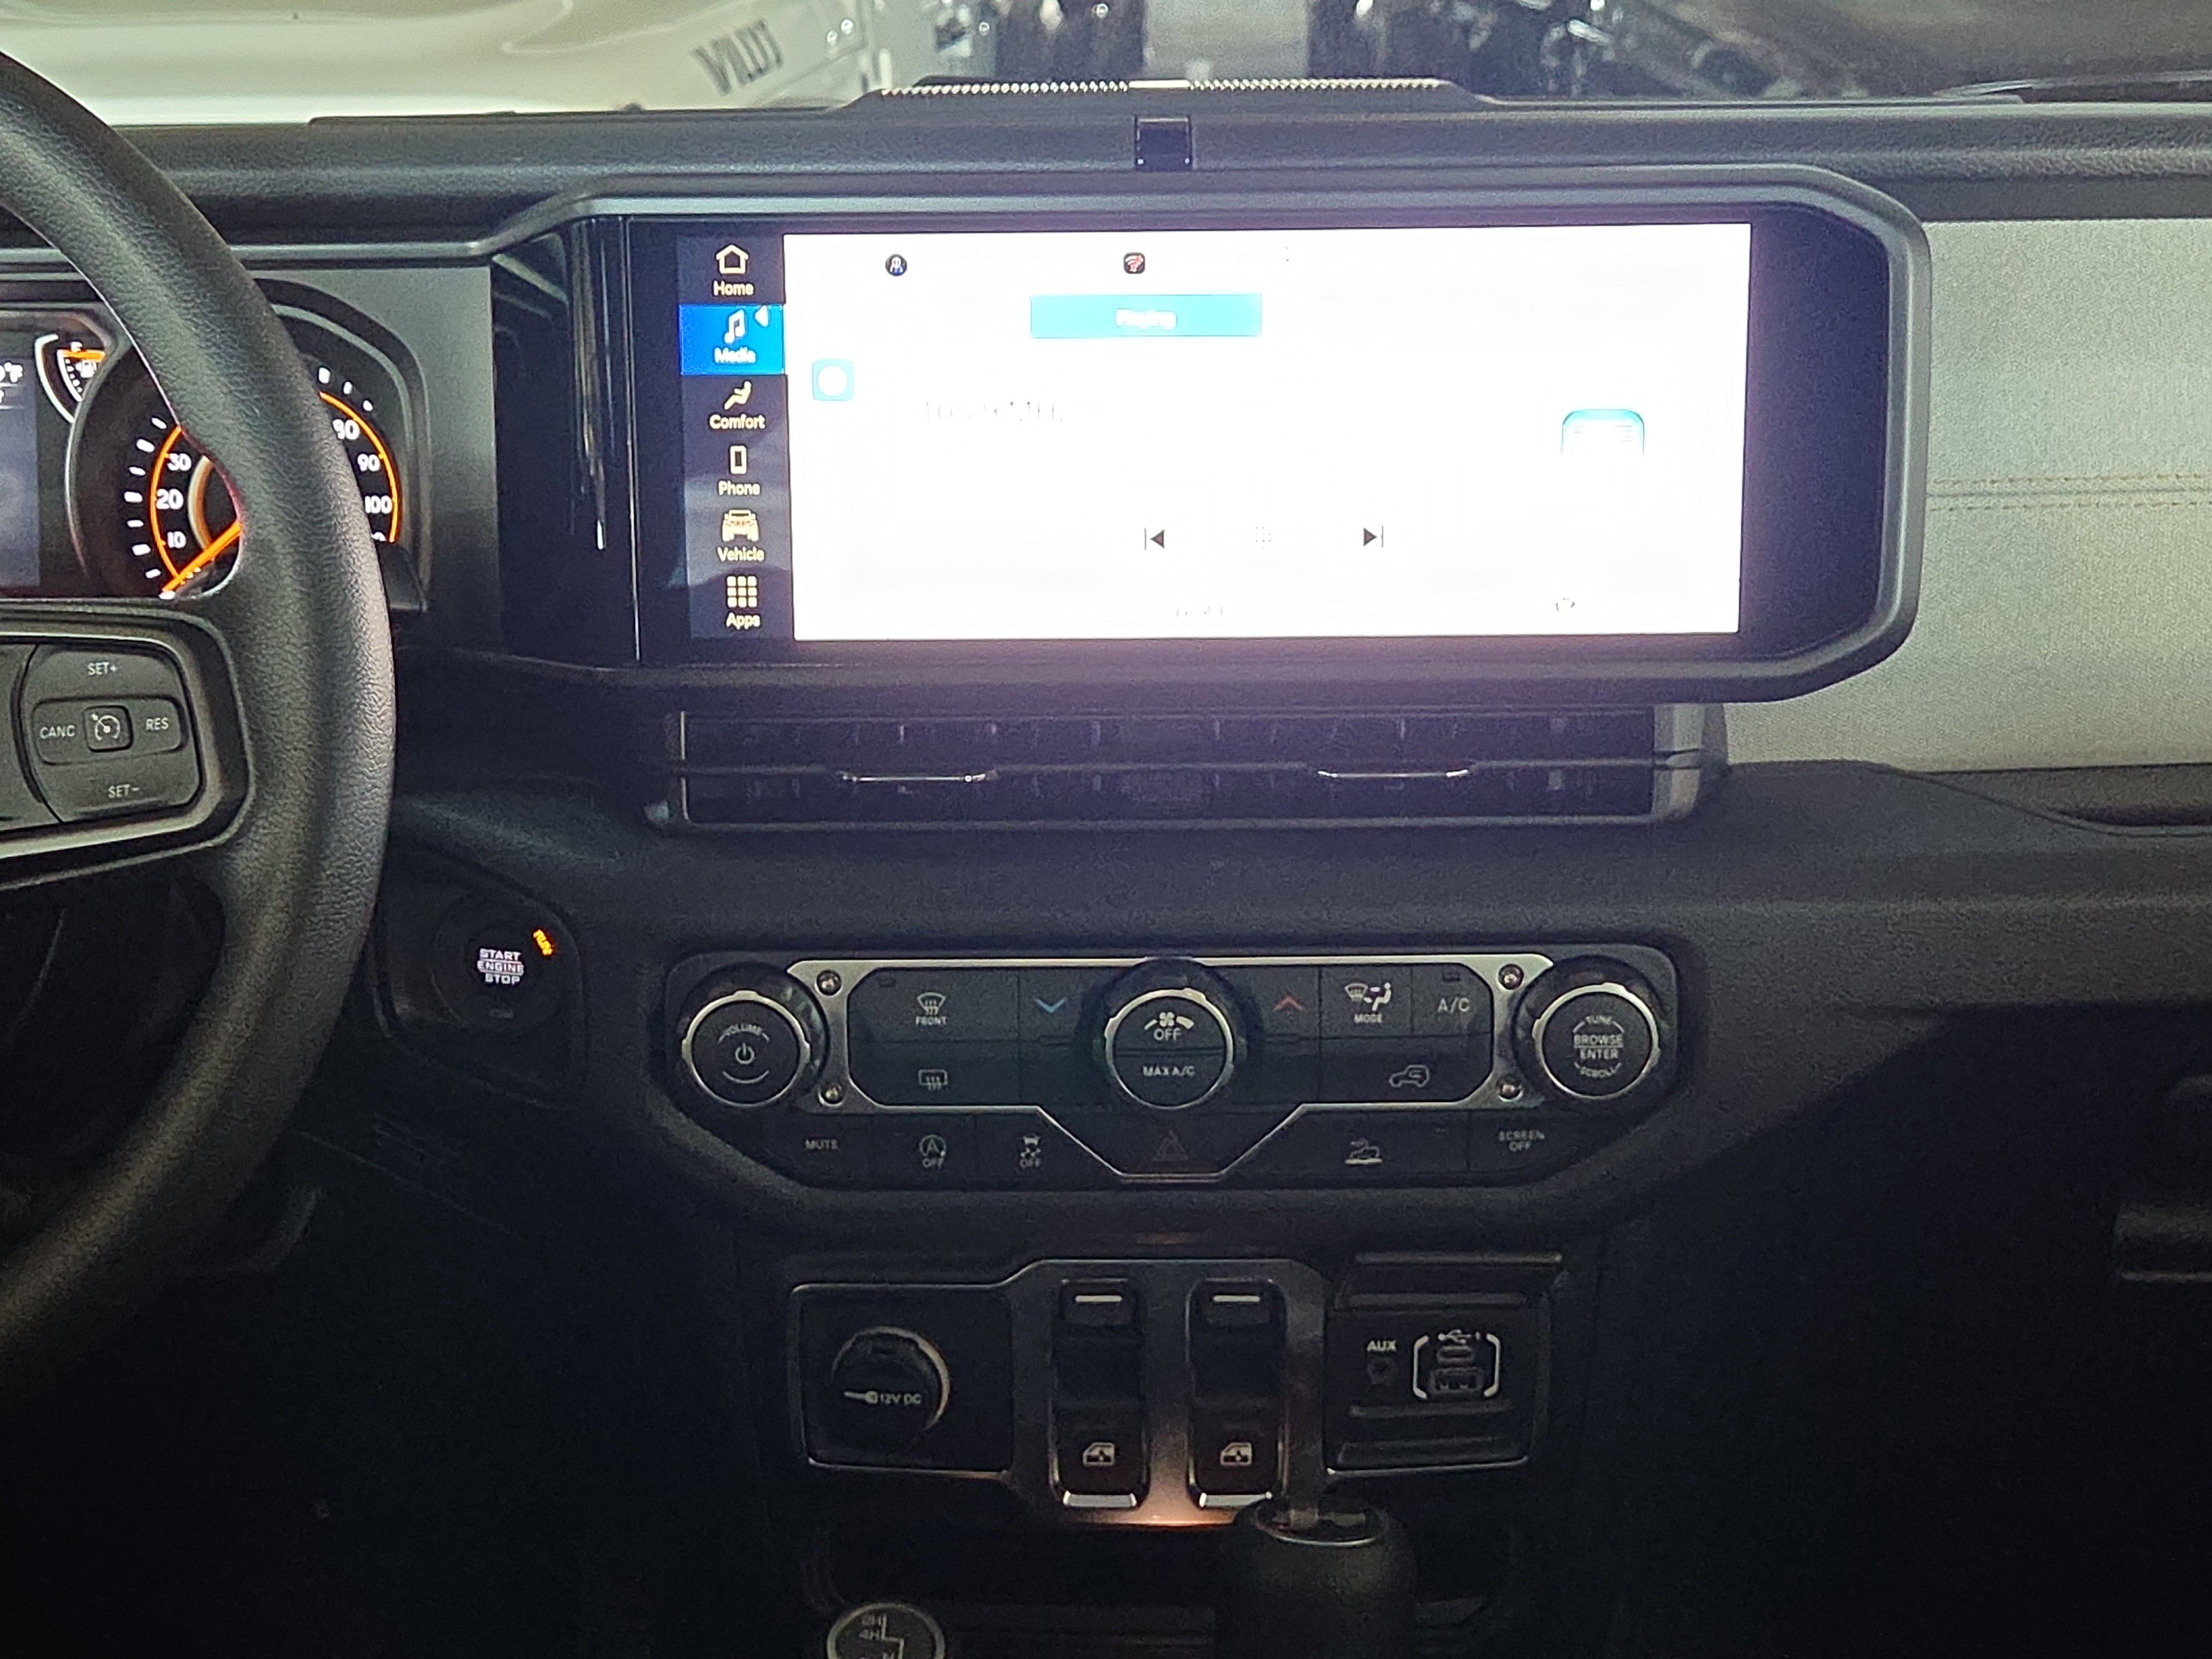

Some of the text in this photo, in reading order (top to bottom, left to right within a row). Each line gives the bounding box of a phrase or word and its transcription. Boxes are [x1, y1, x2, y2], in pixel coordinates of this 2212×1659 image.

[712, 280, 754, 297] Home
[714, 347, 756, 364] Media
[709, 414, 766, 430] Comfort
[168, 453, 192, 471] 30
[357, 453, 380, 472] 90
[718, 480, 761, 496] Phone
[157, 488, 184, 510] 20
[364, 495, 393, 514] 100
[167, 531, 187, 549] 10
[717, 546, 764, 562] Vehicle
[726, 612, 761, 629] Apps
[87, 661, 118, 676] SET+
[40, 724, 75, 739] CANC
[146, 717, 169, 732] RES
[479, 948, 522, 962] START
[477, 960, 524, 975] ENGINE
[485, 974, 520, 986] STOP
[1437, 998, 1471, 1013] A/C
[915, 1016, 948, 1026] FRONT
[1354, 1014, 1382, 1024] MODE
[1153, 1029, 1182, 1040] OFF
[1573, 1034, 1624, 1045] BROWSE
[1580, 1047, 1619, 1060] ENTER
[1142, 1065, 1196, 1077] MAX A/C
[805, 1139, 839, 1150] MUTE
[1508, 1141, 1532, 1153] OFF
[1366, 1340, 1398, 1352] AUX
[879, 1393, 922, 1405] 12V DC
